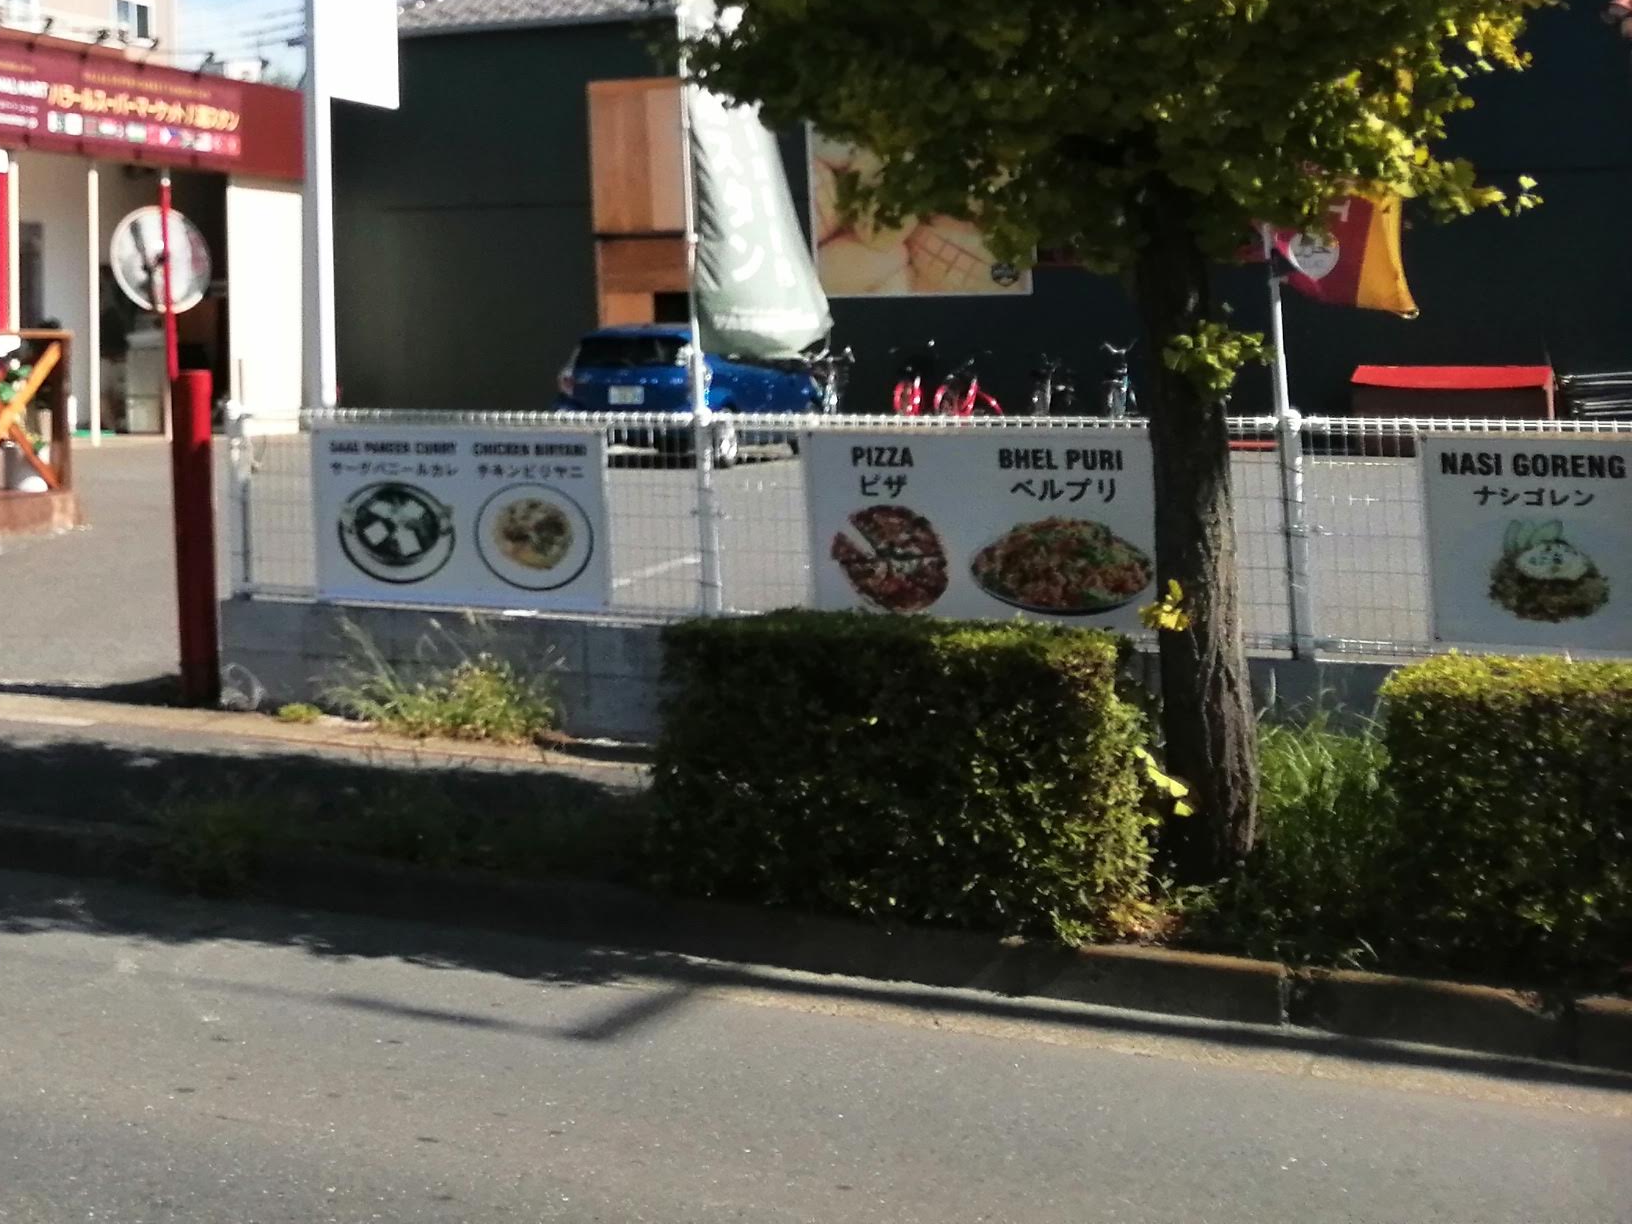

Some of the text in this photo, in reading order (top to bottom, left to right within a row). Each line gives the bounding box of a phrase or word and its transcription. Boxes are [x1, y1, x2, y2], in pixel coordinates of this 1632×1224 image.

[472, 442, 529, 457] CHICKEN
[852, 446, 914, 467] PIZZA
[998, 448, 1123, 471] BHEL PURI
[1441, 452, 1627, 478] NASI GORENG
[1010, 478, 1116, 503] ベルプリ
[1473, 486, 1595, 506] ナシゴレン
